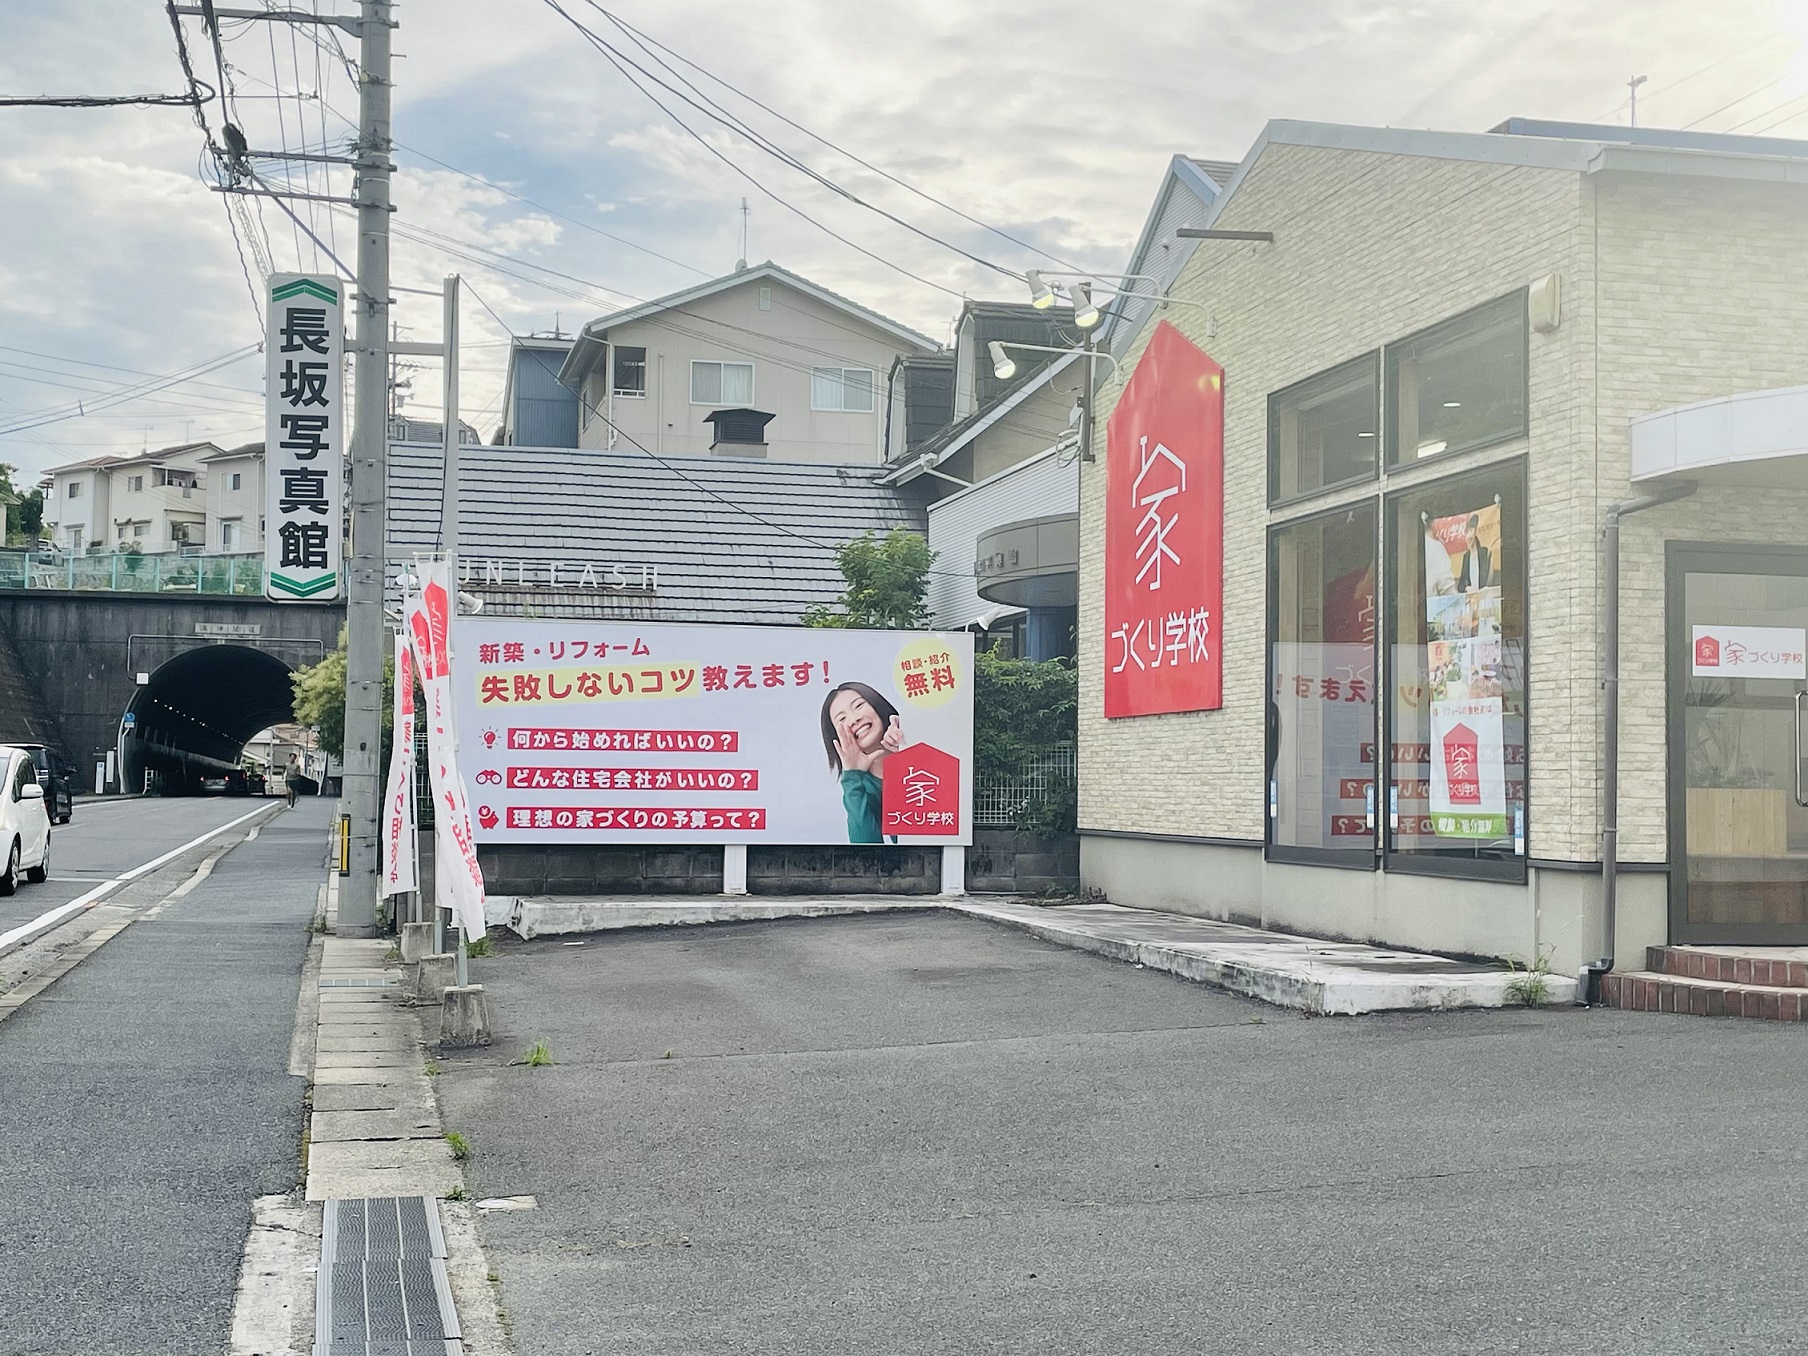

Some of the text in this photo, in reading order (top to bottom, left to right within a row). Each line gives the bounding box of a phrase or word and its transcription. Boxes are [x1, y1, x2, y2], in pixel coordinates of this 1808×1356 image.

[278, 307, 330, 569] 長坂写真館
[1131, 435, 1186, 591] 家
[458, 560, 658, 591] UNLEASH
[479, 638, 650, 664] 新築・リフォーム
[1111, 605, 1210, 673] づくり学校
[901, 652, 950, 671] 相談・紹介
[1725, 640, 1747, 665] 家
[1749, 651, 1803, 664] づくり学校
[904, 665, 955, 698] 無料
[512, 730, 732, 751] 何から始めればいいの？
[1452, 744, 1472, 779] 家
[512, 769, 752, 789] どんな住宅会社がいいの？
[903, 767, 940, 807] 家
[512, 809, 760, 829] 理想の家づくりの予算って？
[887, 811, 954, 826] づくり学校
